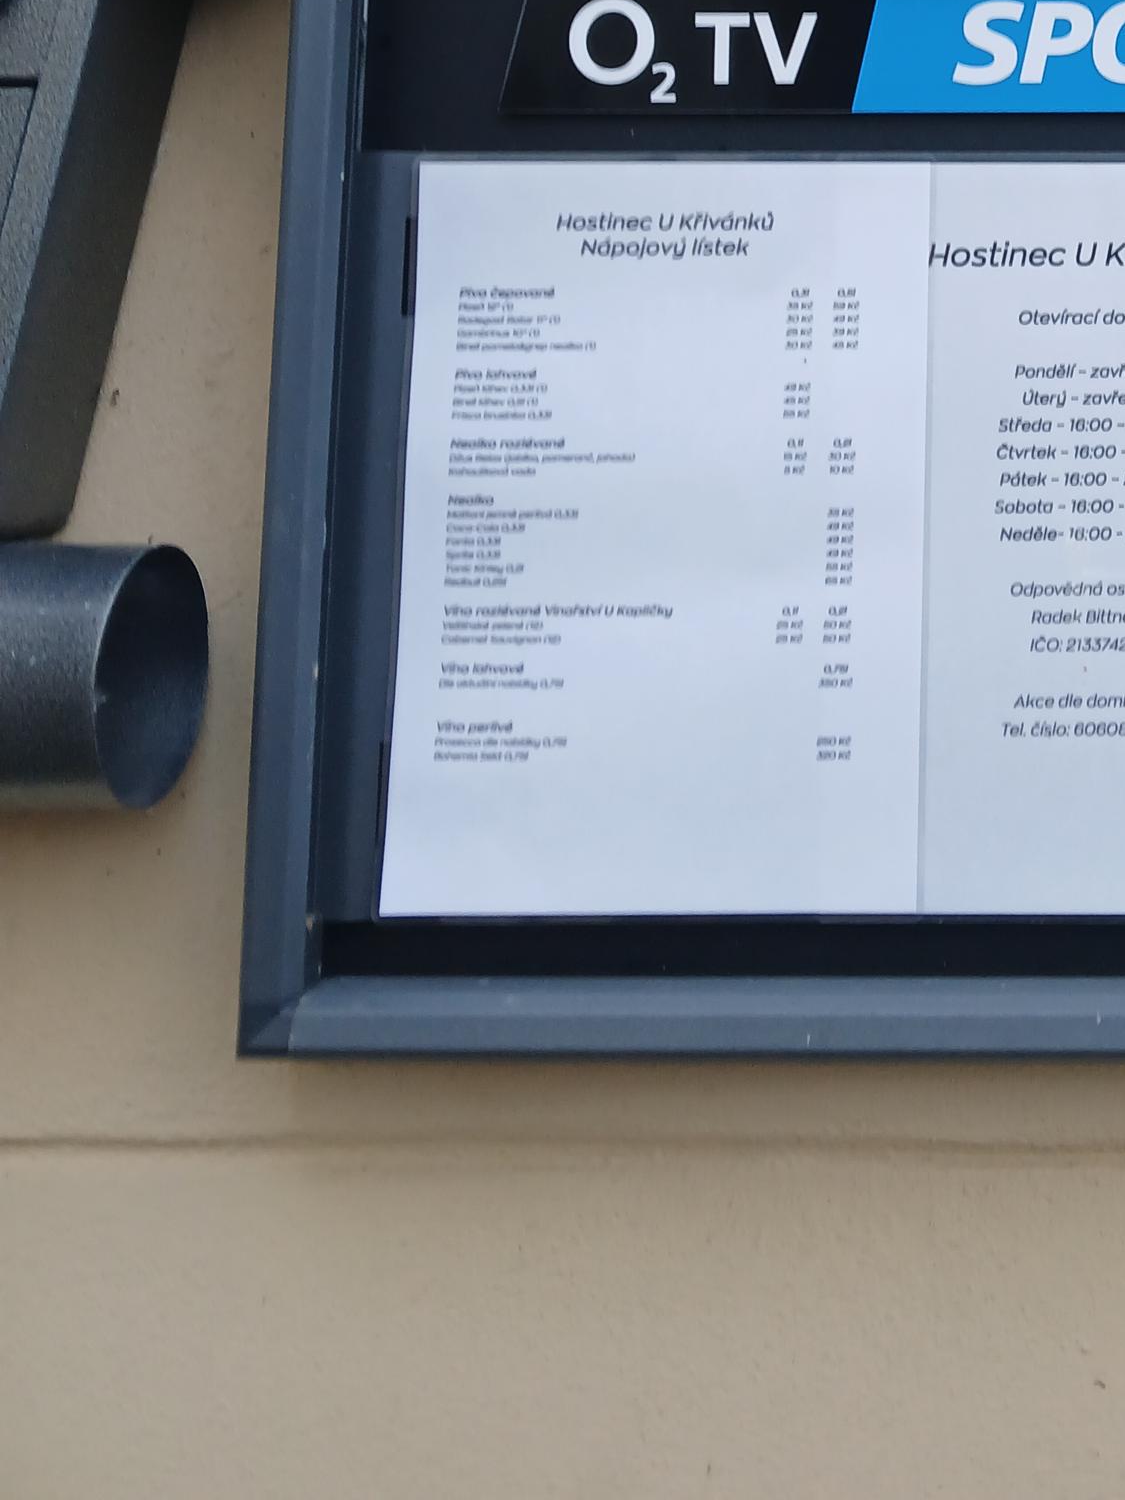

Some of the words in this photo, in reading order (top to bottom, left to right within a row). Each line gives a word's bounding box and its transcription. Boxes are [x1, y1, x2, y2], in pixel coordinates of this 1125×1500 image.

[695, 8, 819, 88] TV
[557, 212, 652, 231] Hostinec
[679, 211, 774, 231] Křivánků
[581, 238, 686, 260] Nápojový
[692, 237, 749, 256] lístek
[929, 241, 1066, 267] Hostinec
[1019, 308, 1101, 325] Otevírací
[1015, 364, 1076, 379] Pondělí
[1022, 389, 1066, 408] Úterý
[998, 417, 1052, 432] Středa
[1070, 418, 1112, 432] 16:00
[997, 443, 1056, 460] Čtvrtek
[1074, 445, 1116, 459] 16:00
[1000, 471, 1047, 487] Pátek
[1065, 472, 1107, 486] 16:00
[995, 499, 1053, 514] Sobota
[1072, 500, 1114, 514] 16:00
[1070, 527, 1112, 541] 16:00
[1011, 580, 1103, 599] Odpovědná
[1031, 609, 1082, 624] Radek
[1030, 636, 1062, 652] IČO:
[1014, 694, 1055, 709] Akce
[1058, 694, 1083, 708] dle
[1003, 722, 1026, 737] Tel.
[1030, 721, 1070, 737] číslo:
